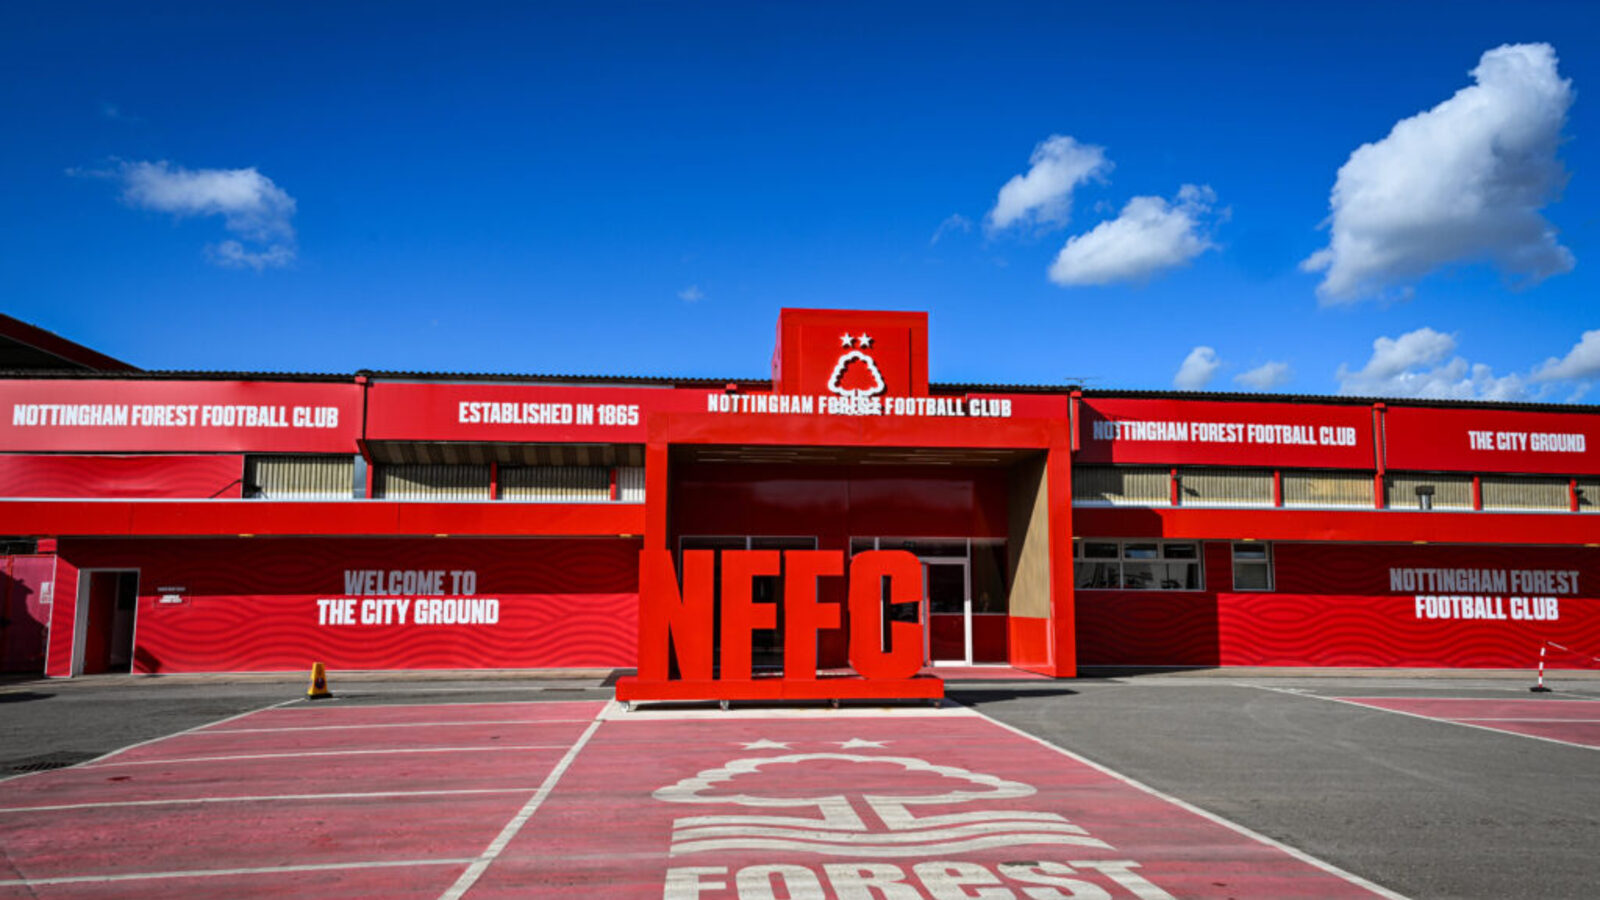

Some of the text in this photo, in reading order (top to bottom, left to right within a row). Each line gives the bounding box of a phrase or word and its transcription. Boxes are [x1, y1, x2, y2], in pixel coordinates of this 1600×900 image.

[13, 404, 339, 428] NOTTINGHAM FOREST FOOTBALL CLUB
[459, 402, 639, 426] ESTABLISHED IN 1865
[708, 394, 813, 414] NOTTINGHAM
[885, 397, 965, 416] FOOTBALL
[970, 399, 1012, 417] CLUB
[1093, 421, 1357, 446] NOTTINGHAM FOREST FOOTBALL CLUB
[1468, 431, 1586, 452] THE CITY GROUND
[344, 570, 477, 596] WELCOME TO
[1389, 568, 1580, 594] NOTTINGHAM FOREST
[317, 599, 500, 625] THE CITY GROUND
[637, 549, 924, 681] NFFC
[1415, 595, 1560, 621] FOOTBALL CLUB
